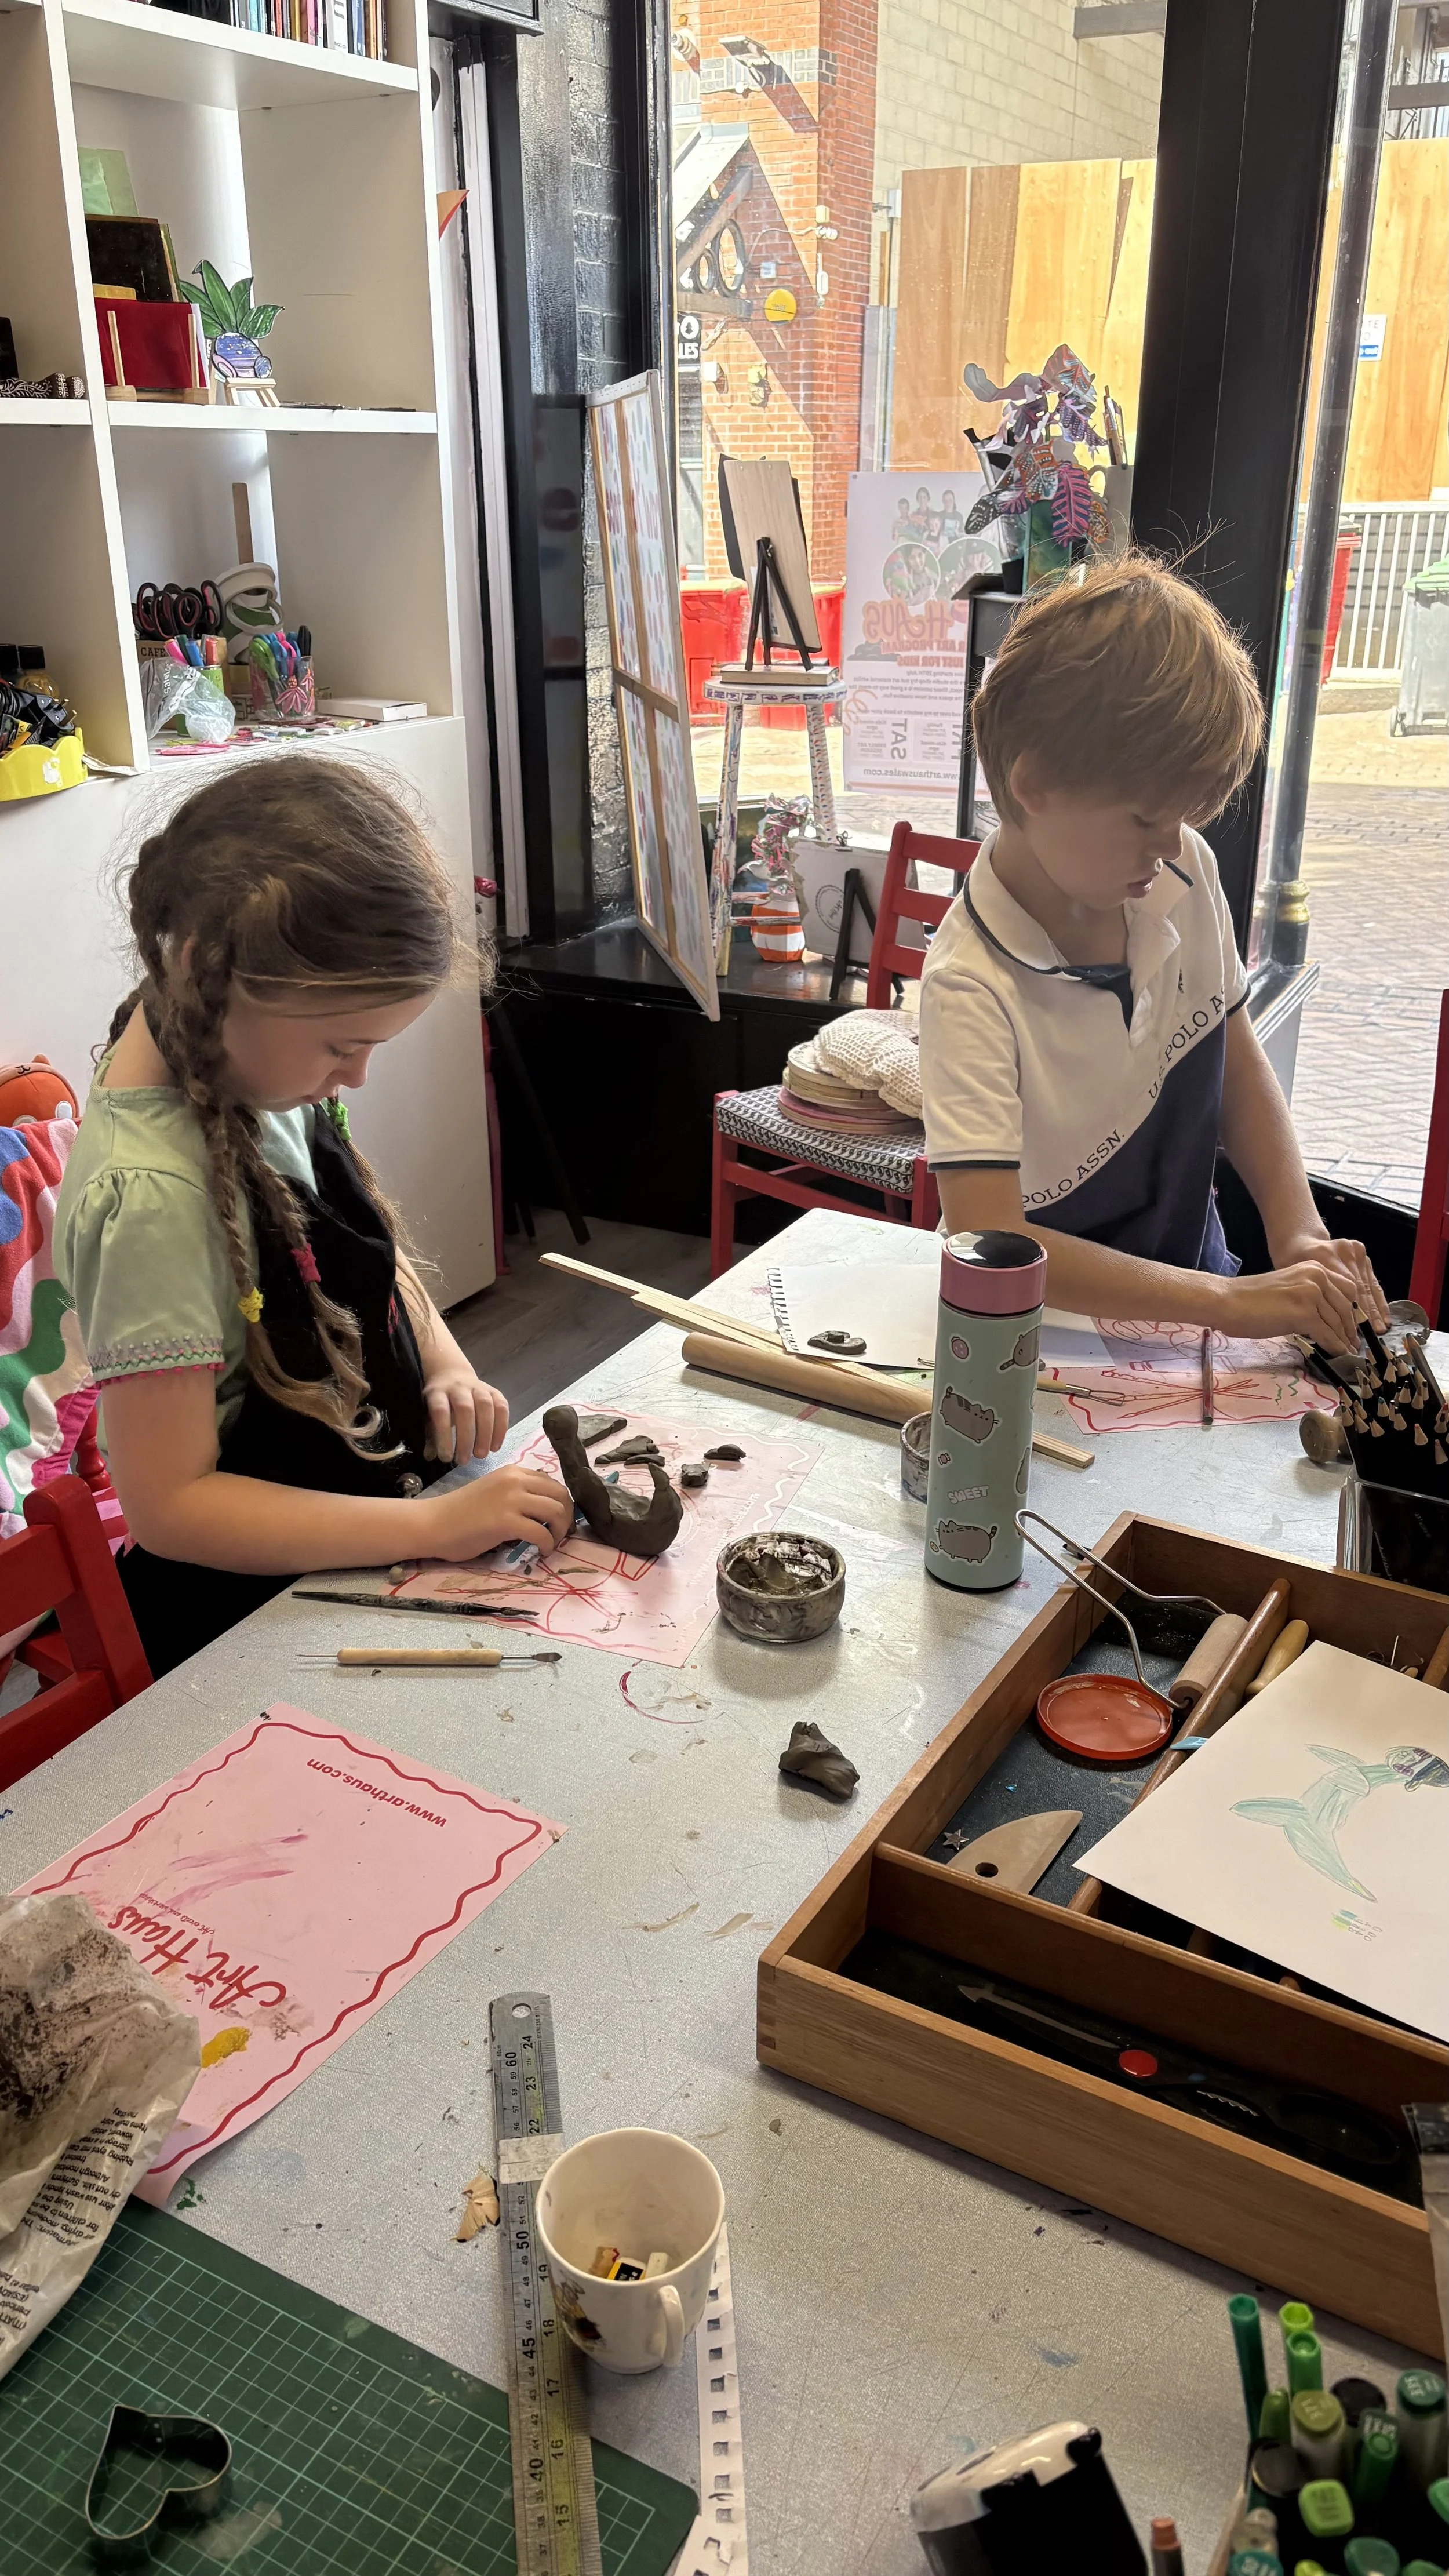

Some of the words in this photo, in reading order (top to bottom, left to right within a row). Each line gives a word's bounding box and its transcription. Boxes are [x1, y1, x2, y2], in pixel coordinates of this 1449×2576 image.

[1164, 1010, 1208, 1063] POLO
[1022, 1179, 1072, 1207] POLO
[1076, 1129, 1125, 1181] ASSN.
[947, 1484, 989, 1504] SWEET
[306, 1758, 447, 1827] www.arthaus.com
[107, 1906, 199, 1975] Haus
[185, 1952, 287, 2010] Art
[522, 2036, 532, 2049] 24
[505, 2051, 517, 2067] 60
[510, 2071, 517, 2080] 59
[525, 2076, 536, 2091] 23
[511, 2088, 518, 2097] 58
[512, 2105, 519, 2113] 57
[514, 2122, 520, 2131] 56
[529, 2118, 540, 2134] 22
[516, 2231, 530, 2250] 50
[522, 2255, 529, 2266] 49
[539, 2264, 549, 2282] 19
[523, 2276, 530, 2287] 48
[523, 2298, 531, 2309] 47
[526, 2320, 533, 2331] 46
[543, 2319, 555, 2338] 18
[522, 2337, 536, 2359] 45
[547, 2378, 559, 2397] 17
[531, 2413, 538, 2426] 42
[551, 2439, 564, 2461] 16
[529, 2458, 544, 2482] 40
[537, 2515, 545, 2529] 38
[555, 2504, 570, 2527] 15
[539, 2544, 547, 2557] 37
